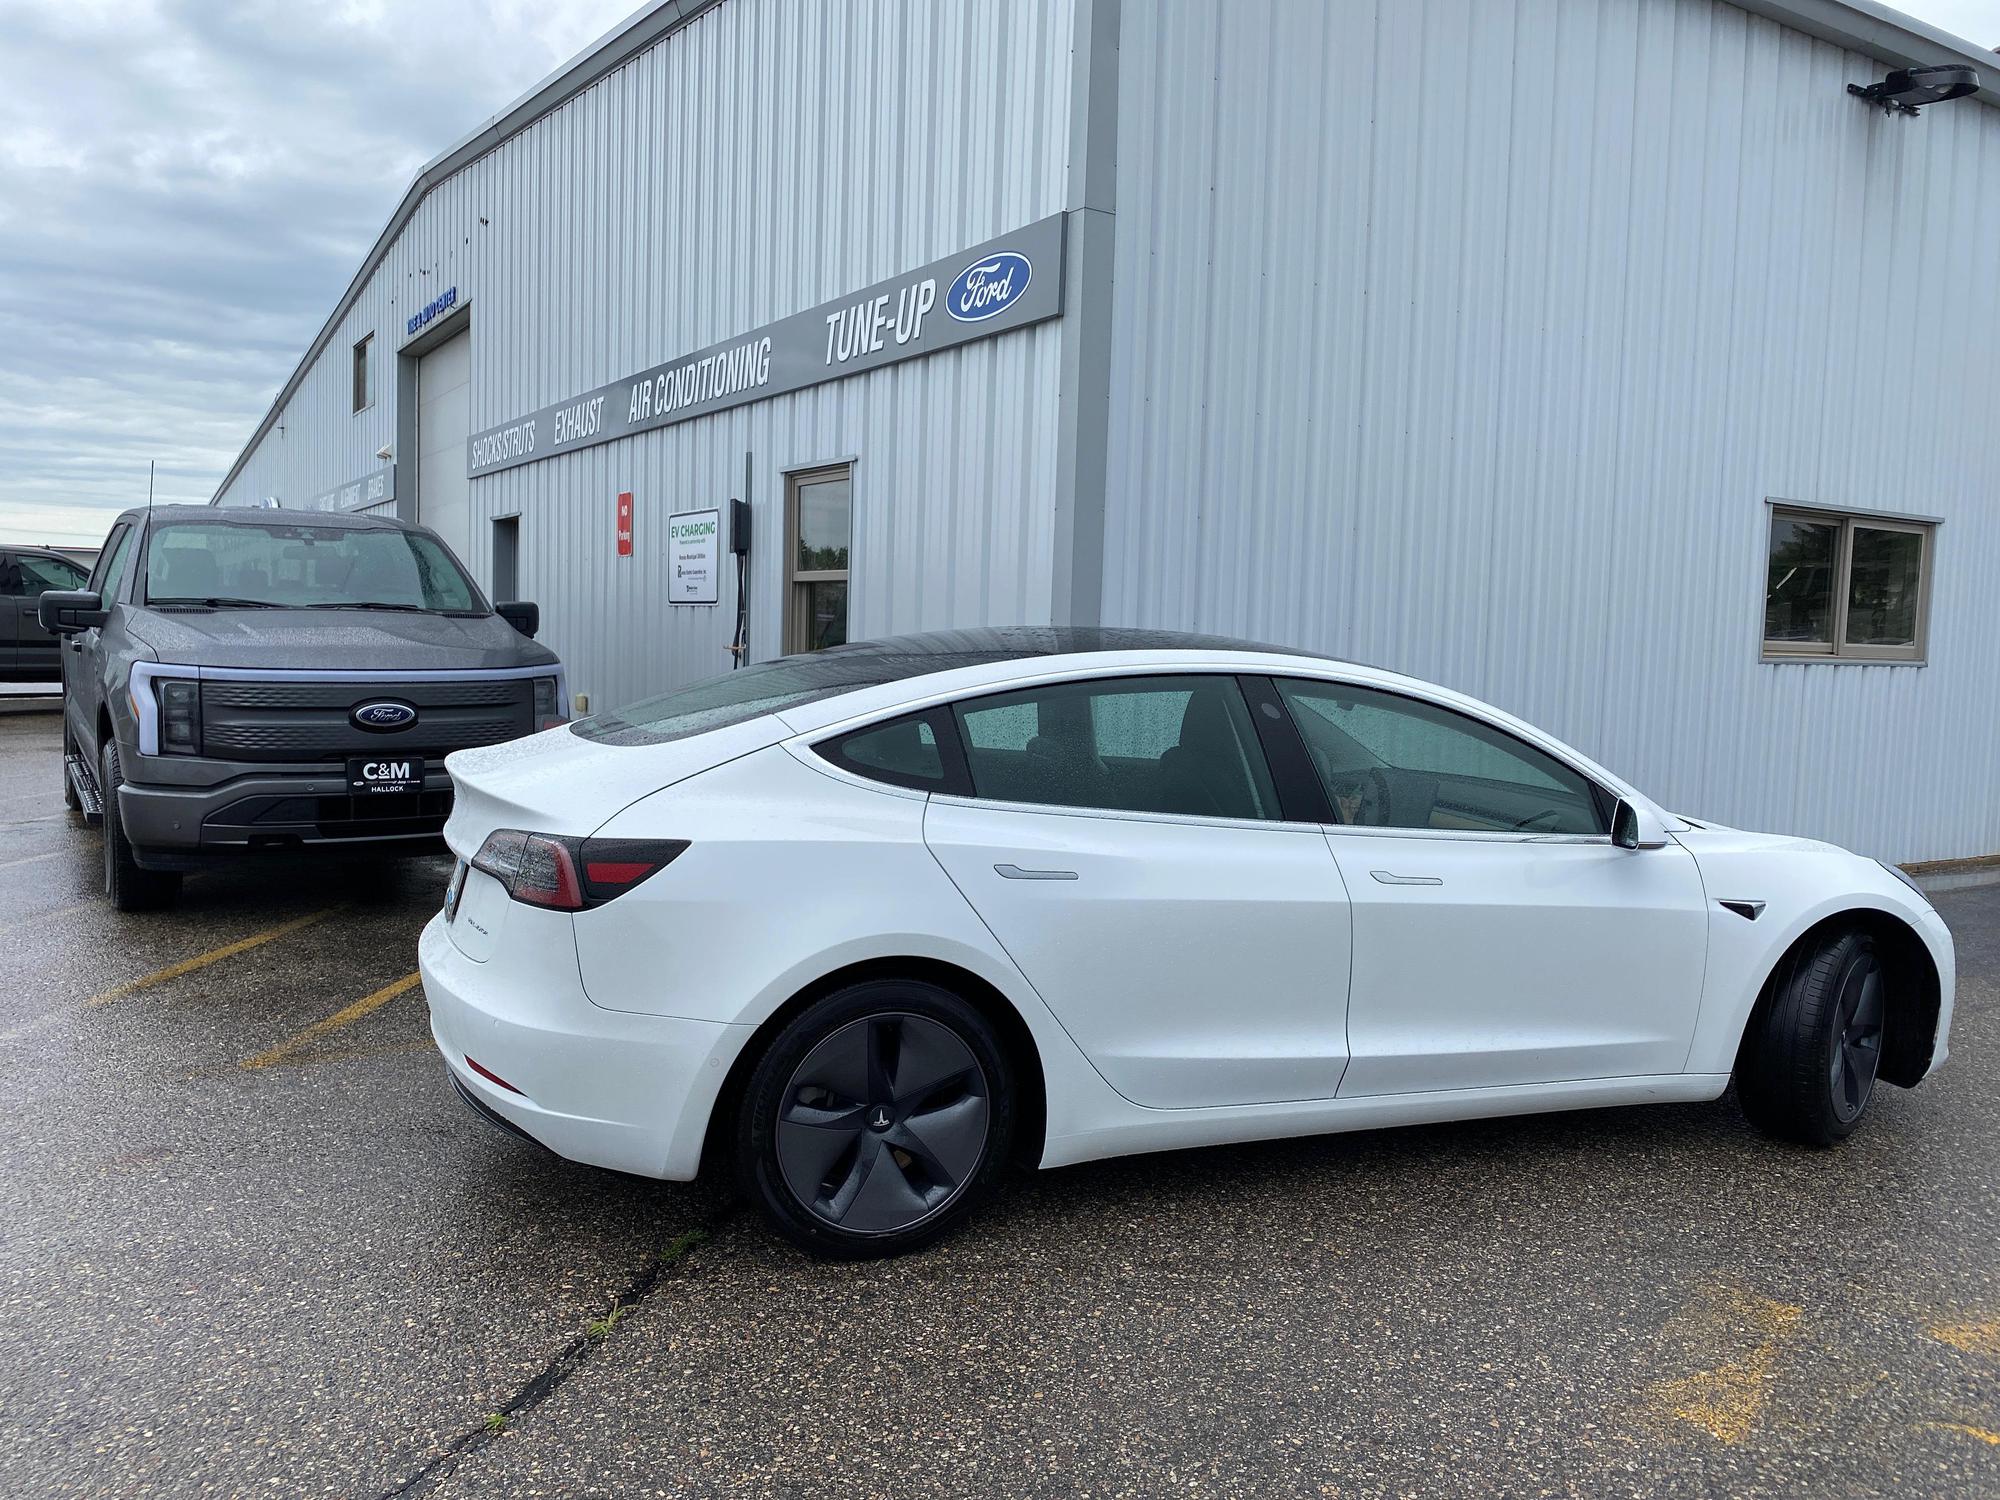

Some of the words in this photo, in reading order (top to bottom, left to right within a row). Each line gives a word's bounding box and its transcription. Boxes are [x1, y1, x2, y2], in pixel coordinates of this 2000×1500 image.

[960, 262, 1015, 313] Ford
[472, 419, 536, 470] SHOCKS/STRUTS
[554, 396, 605, 446] EXHAUST
[628, 379, 652, 424] AIR
[654, 336, 771, 416] CONDITIONING
[826, 278, 937, 365] TUNE-UP
[621, 505, 628, 516] NO
[671, 526, 680, 538] EV
[680, 521, 716, 537] CHARGING
[370, 708, 402, 721] Ford
[363, 762, 410, 779] C&M
